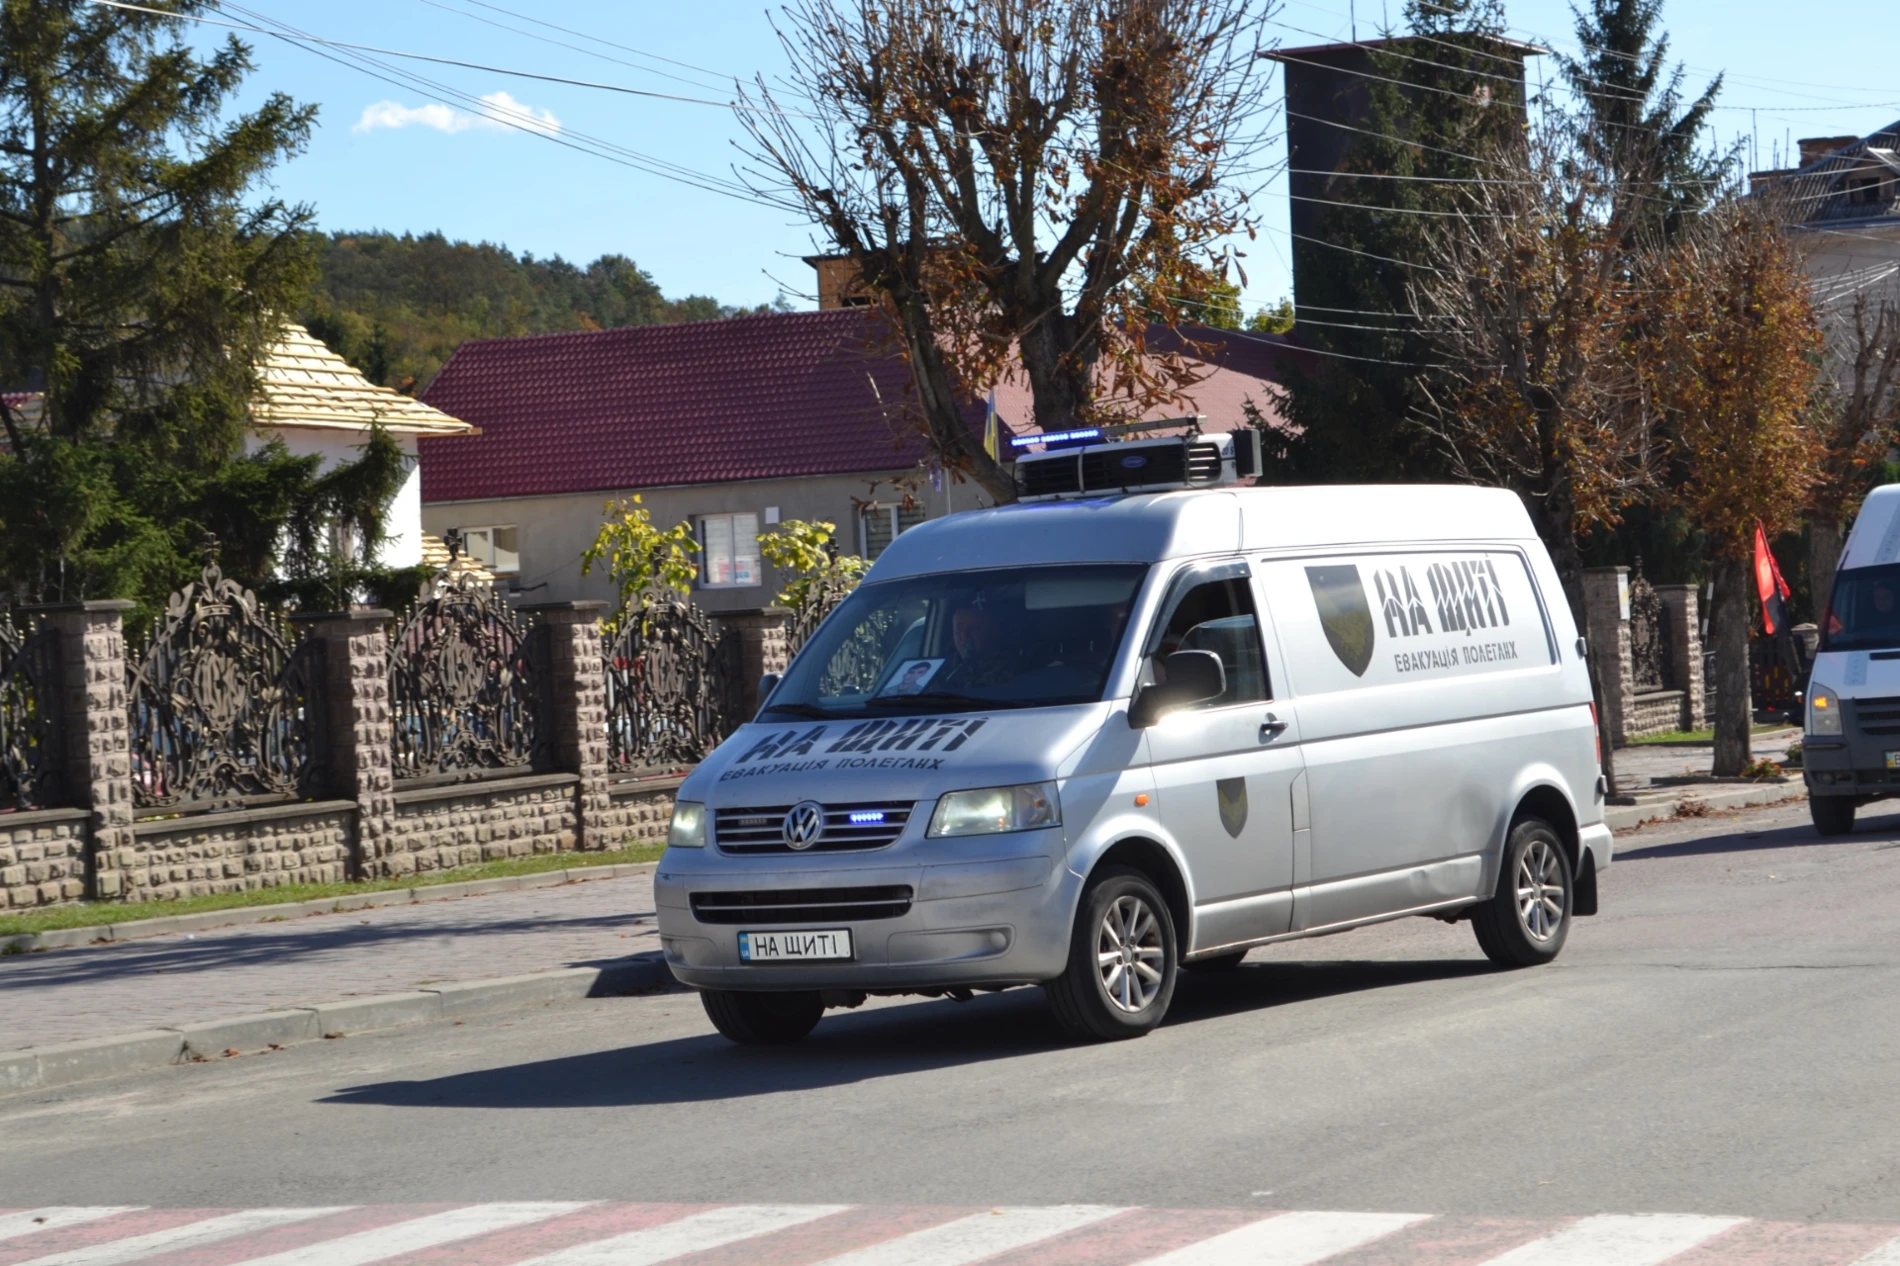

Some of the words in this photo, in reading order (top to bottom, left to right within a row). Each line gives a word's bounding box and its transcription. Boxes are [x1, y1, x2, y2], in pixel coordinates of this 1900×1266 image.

[1373, 566, 1433, 638] НА
[1394, 646, 1459, 672] ЕВАКУАЦІЯ
[735, 725, 829, 764] НА
[825, 717, 989, 754] ЩИТІ
[719, 759, 828, 782] ЕВАКУАЦІЯ
[755, 936, 779, 956] НА
[784, 935, 837, 955] ЩИТІ
